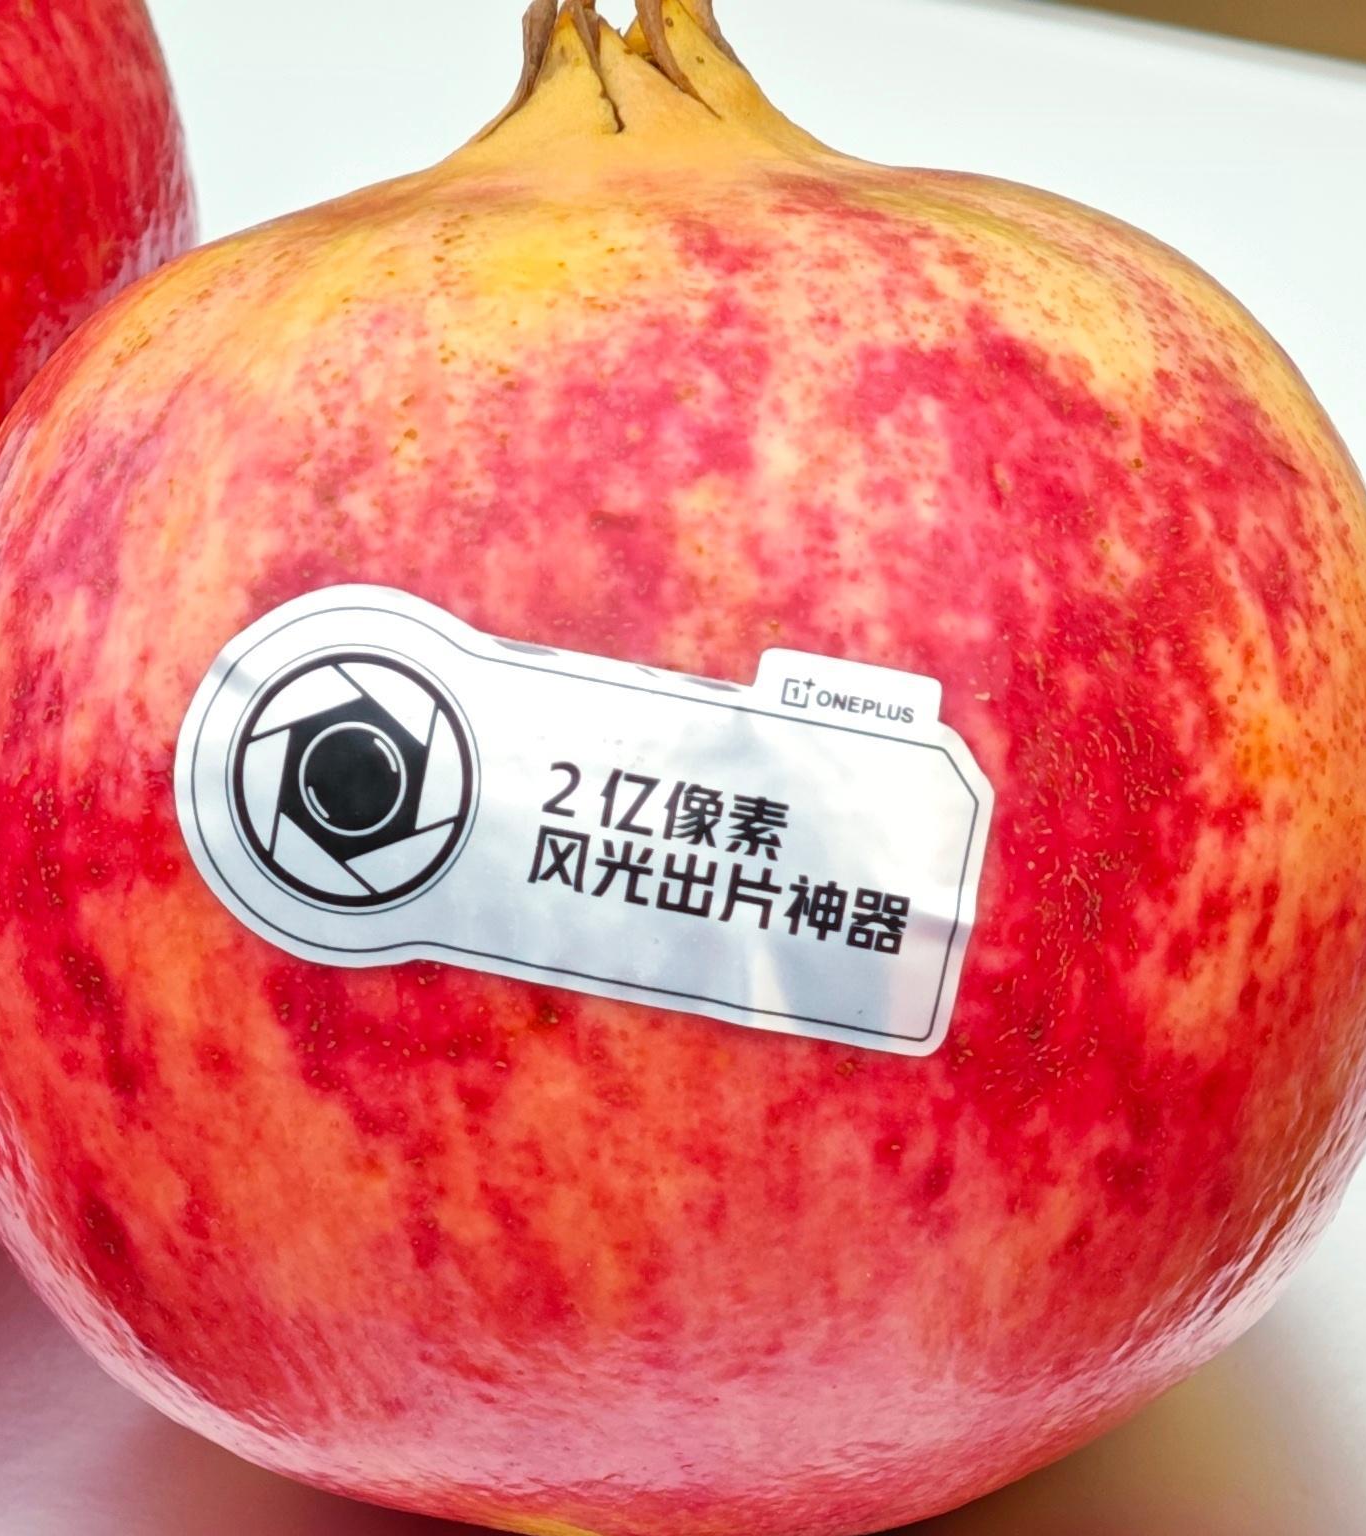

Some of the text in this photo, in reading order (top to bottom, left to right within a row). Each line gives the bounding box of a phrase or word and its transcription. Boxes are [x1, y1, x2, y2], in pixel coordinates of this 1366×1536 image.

[816, 690, 914, 723] ONEPLUS
[527, 825, 910, 955] 风光出片神器
